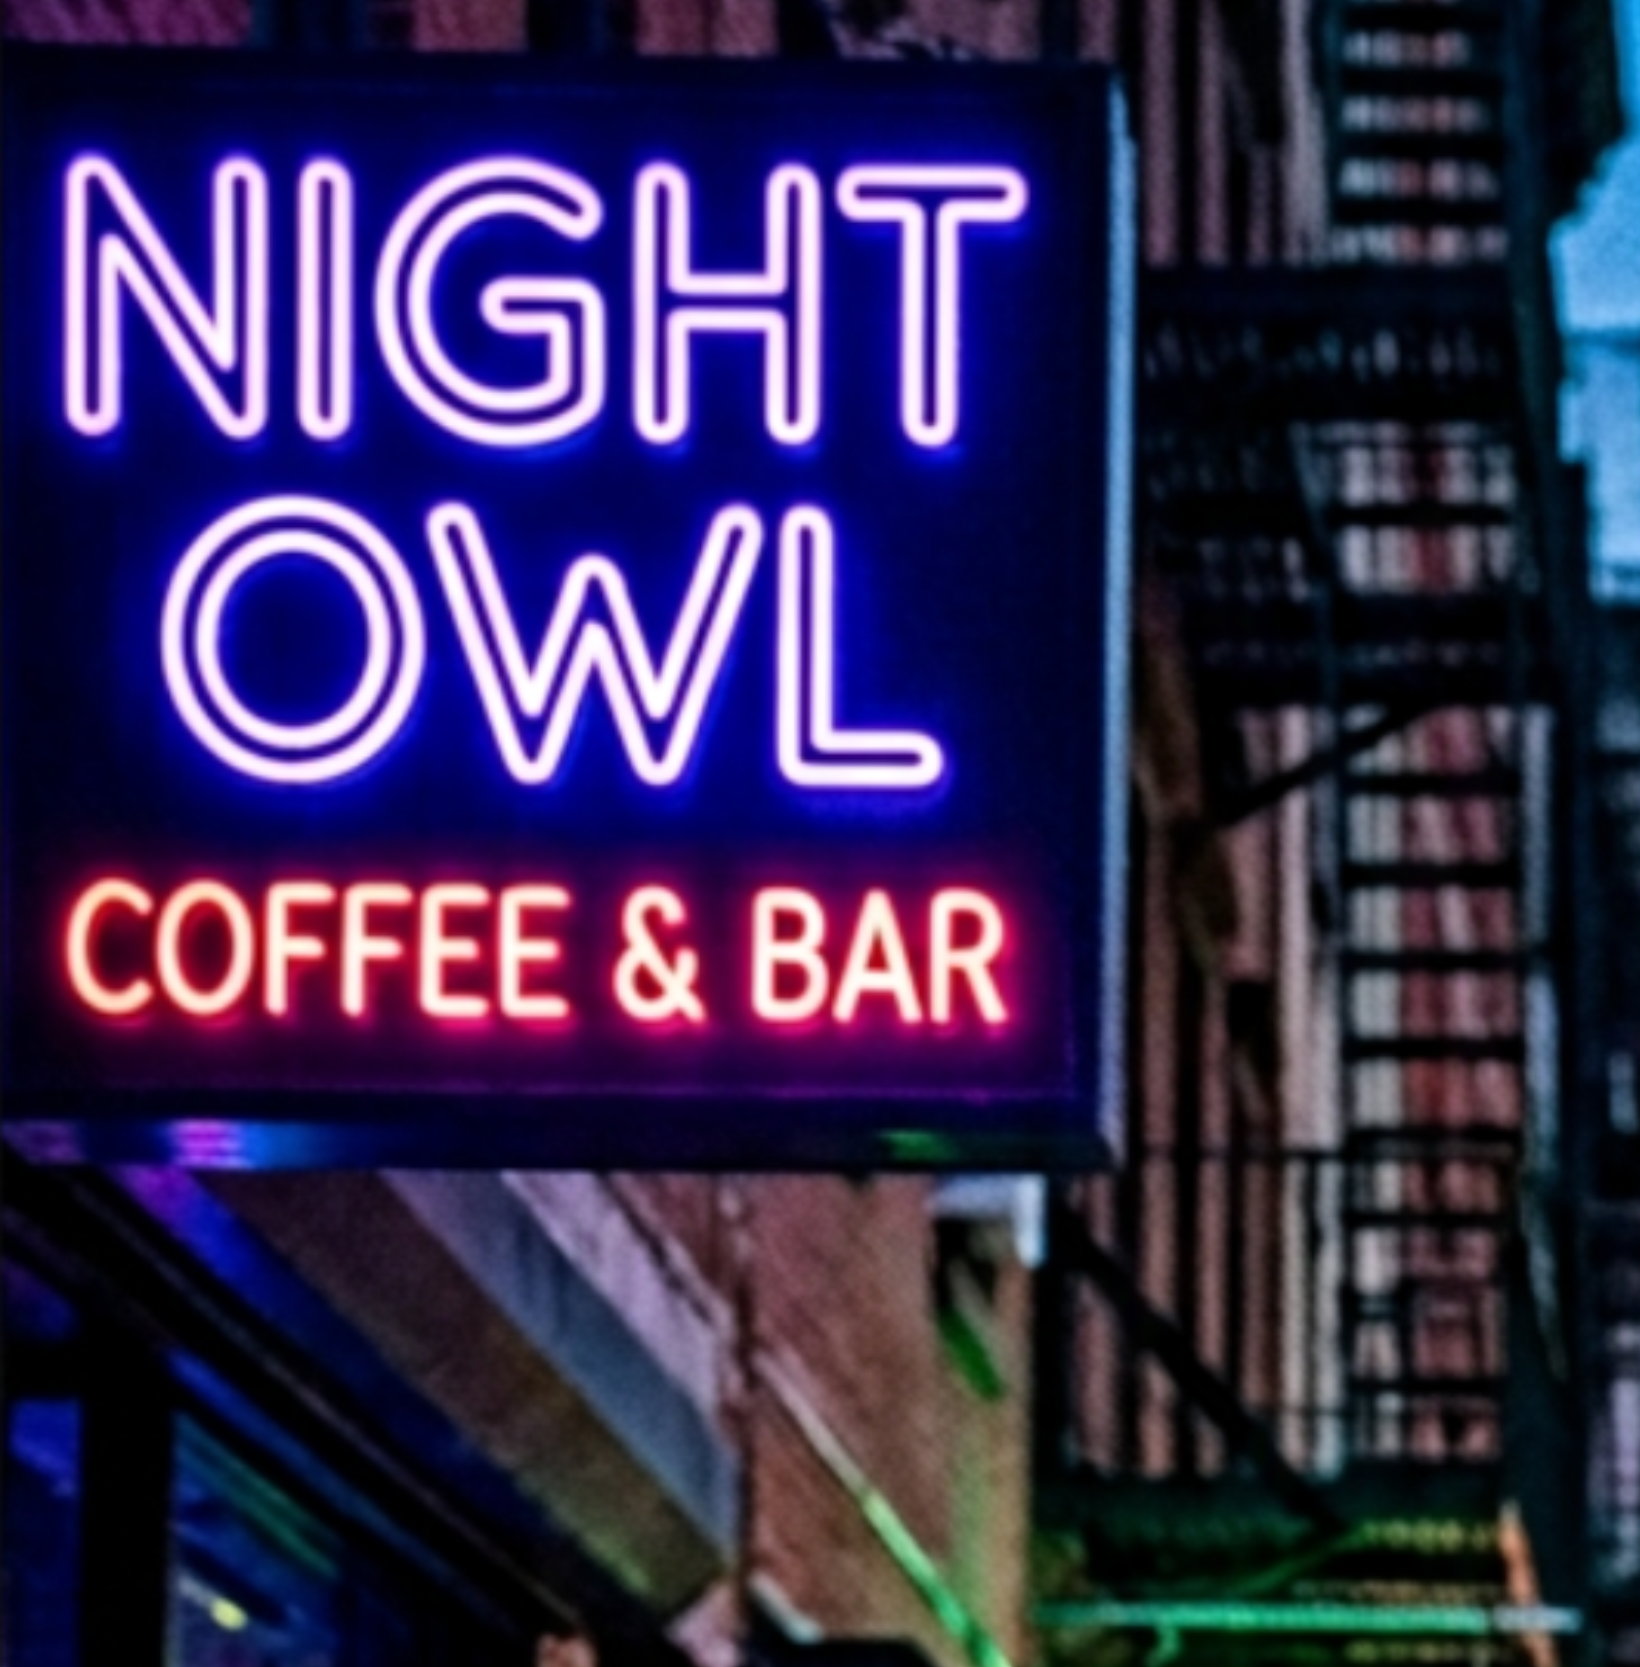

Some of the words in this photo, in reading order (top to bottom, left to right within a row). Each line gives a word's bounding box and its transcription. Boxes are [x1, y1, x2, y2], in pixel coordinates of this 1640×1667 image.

[63, 152, 1028, 448] NIGHT
[159, 493, 945, 788] OWL
[65, 877, 570, 1018] COFFEE
[612, 884, 706, 1022] &
[750, 887, 1008, 1024] BAR
